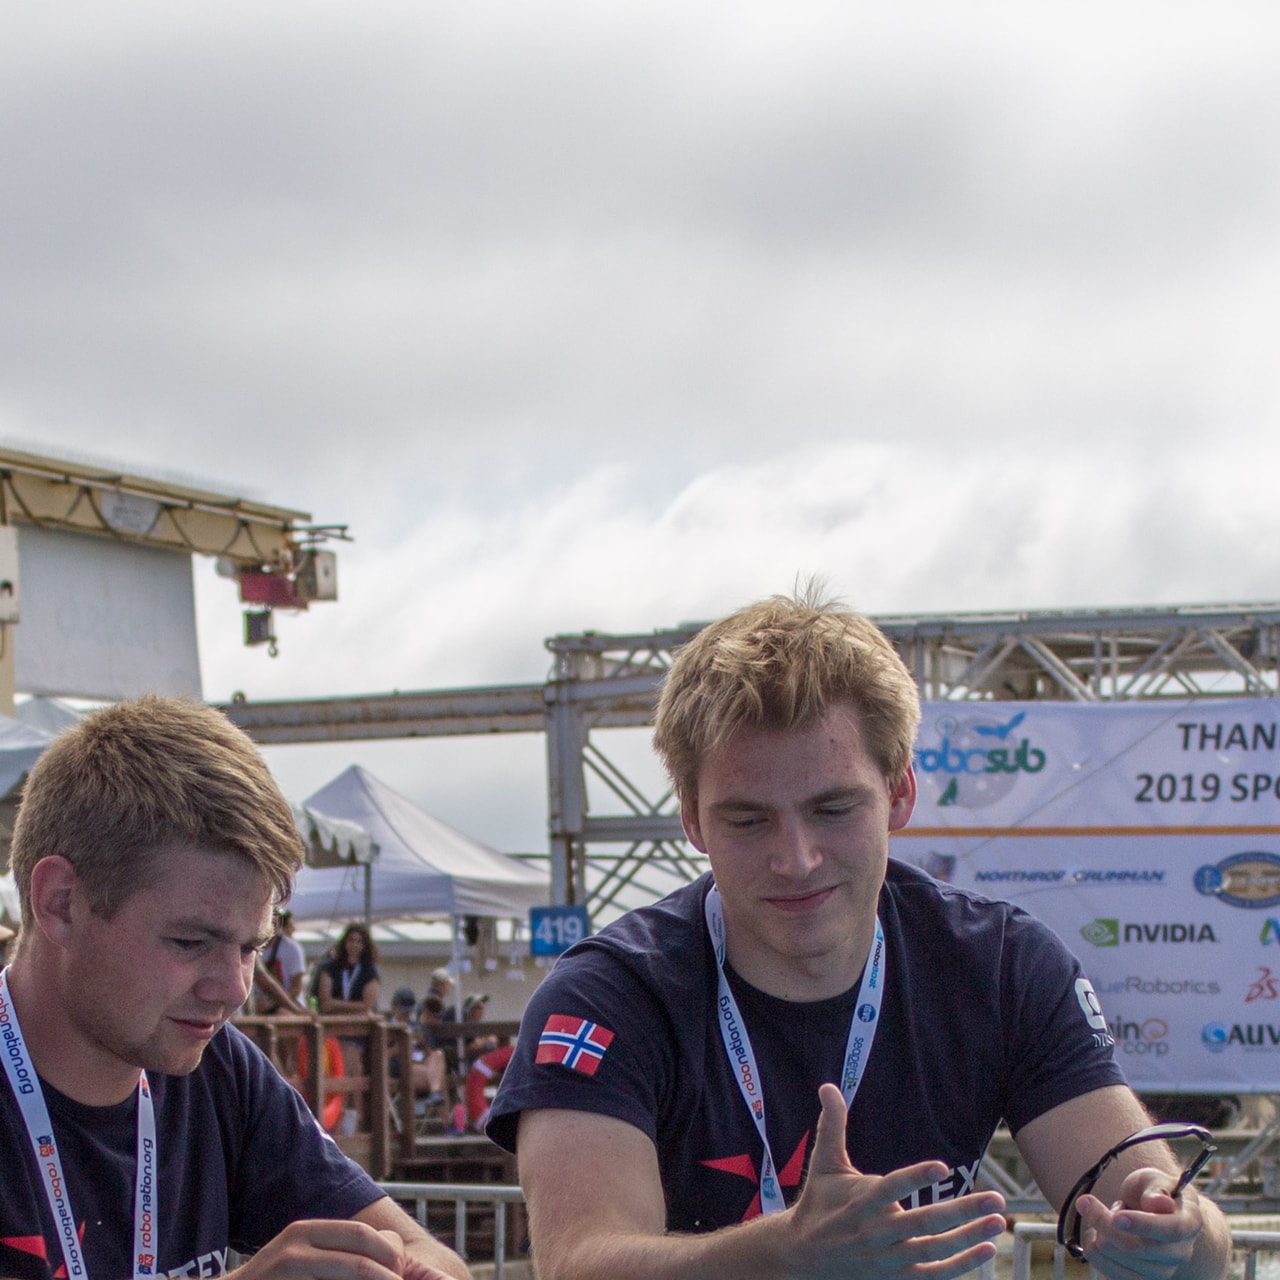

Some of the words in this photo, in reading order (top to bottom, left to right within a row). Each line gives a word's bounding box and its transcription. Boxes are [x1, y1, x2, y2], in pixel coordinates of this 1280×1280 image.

[1134, 773, 1220, 802] 2019
[974, 870, 1067, 882] NORTHROP
[1073, 870, 1167, 882] GRUMMAN
[535, 916, 583, 945] 419
[720, 995, 757, 1096] robonation.org
[46, 1162, 82, 1276] robonation.org
[139, 1138, 154, 1248] robonation.org
